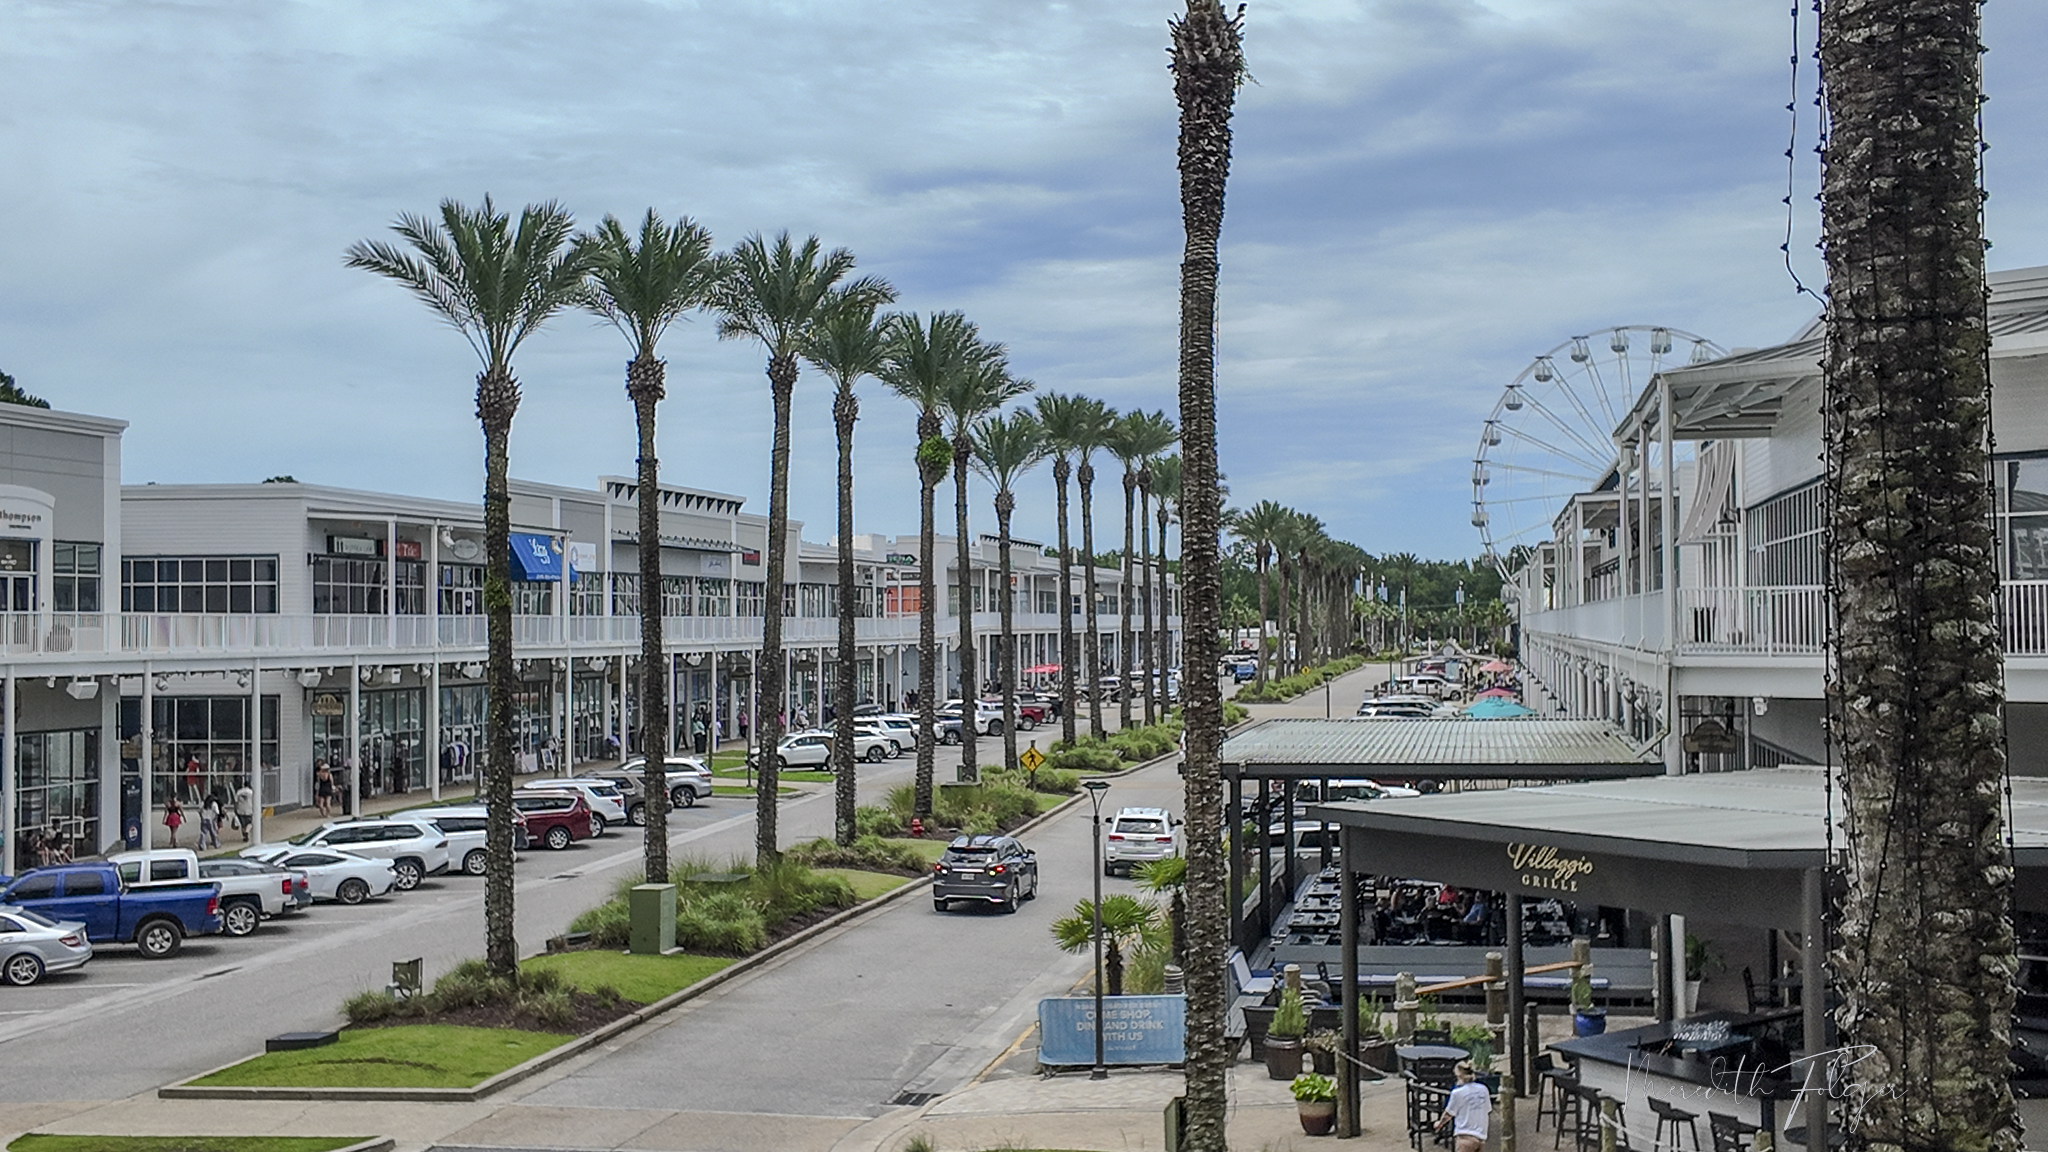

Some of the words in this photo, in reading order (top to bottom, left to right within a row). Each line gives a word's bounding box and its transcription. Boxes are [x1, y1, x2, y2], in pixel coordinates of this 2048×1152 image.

[1507, 842, 1594, 881] Villaggio
[1521, 874, 1579, 893] GRILLE
[1085, 1010, 1118, 1020] CME
[1076, 1021, 1100, 1031] DIN
[1104, 1021, 1128, 1031] AND
[1130, 1020, 1164, 1030] DRINK
[1128, 1032, 1144, 1041] US
